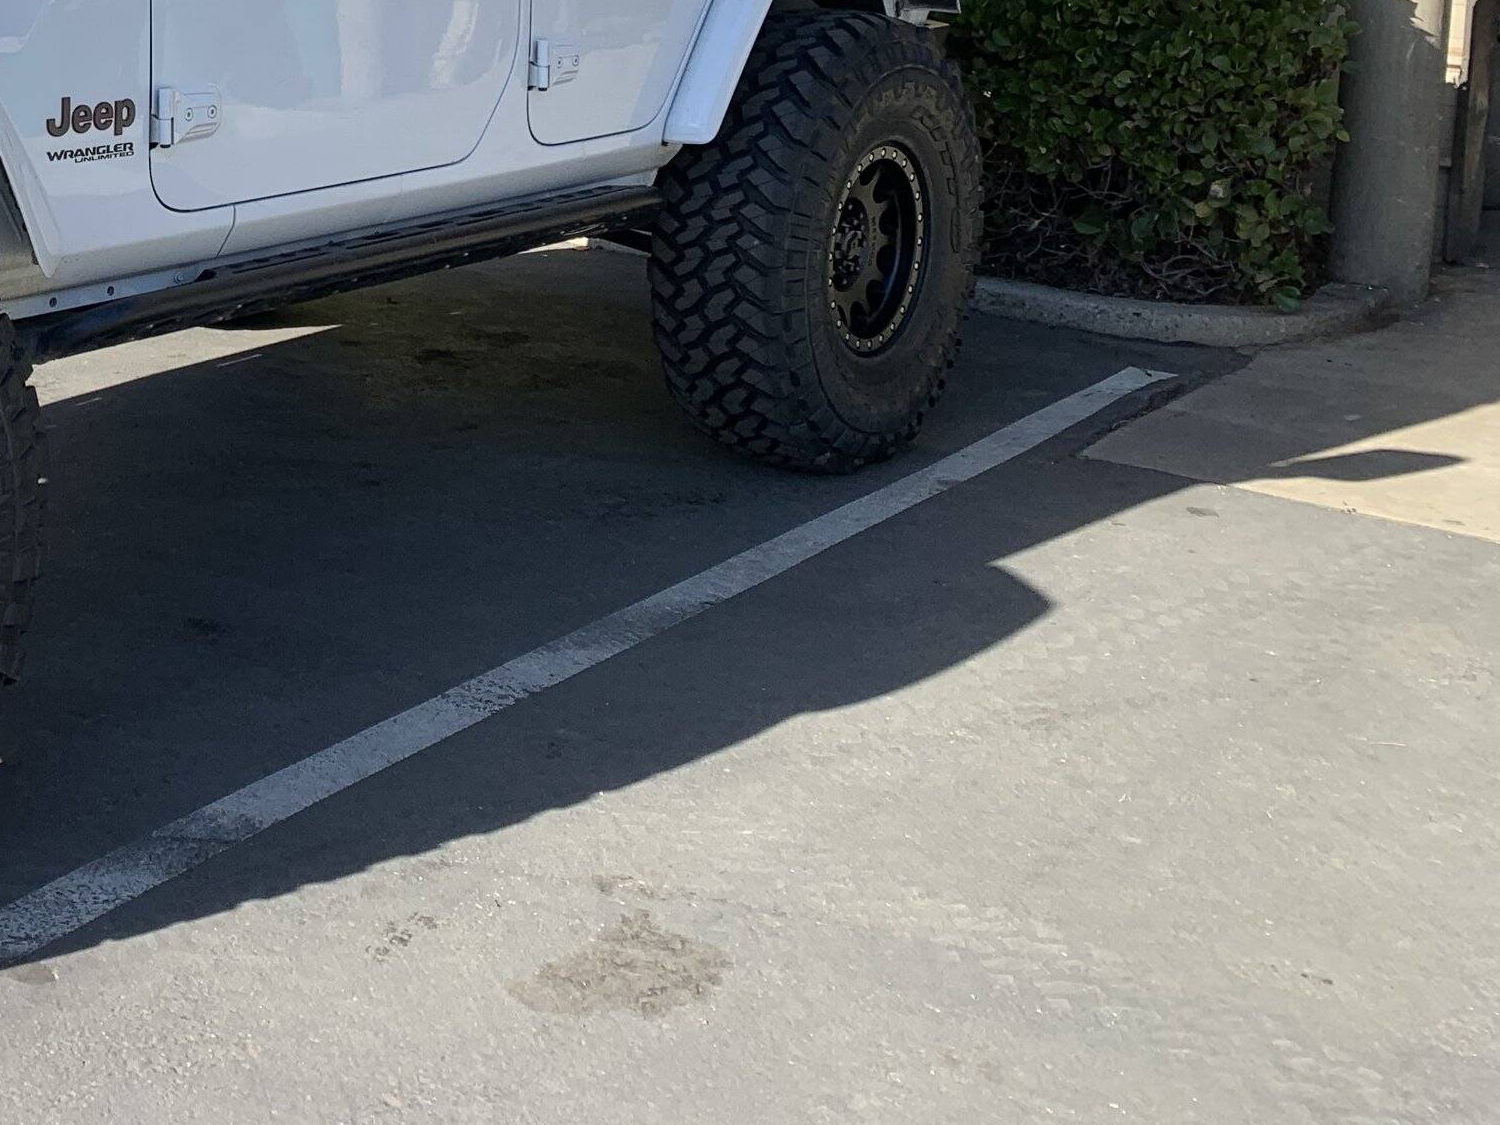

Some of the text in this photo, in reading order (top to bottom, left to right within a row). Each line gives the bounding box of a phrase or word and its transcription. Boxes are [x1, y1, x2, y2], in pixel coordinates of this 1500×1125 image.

[46, 96, 136, 138] Jeep
[46, 141, 135, 162] WRANGLER
[74, 150, 135, 163] UNLIMITED
